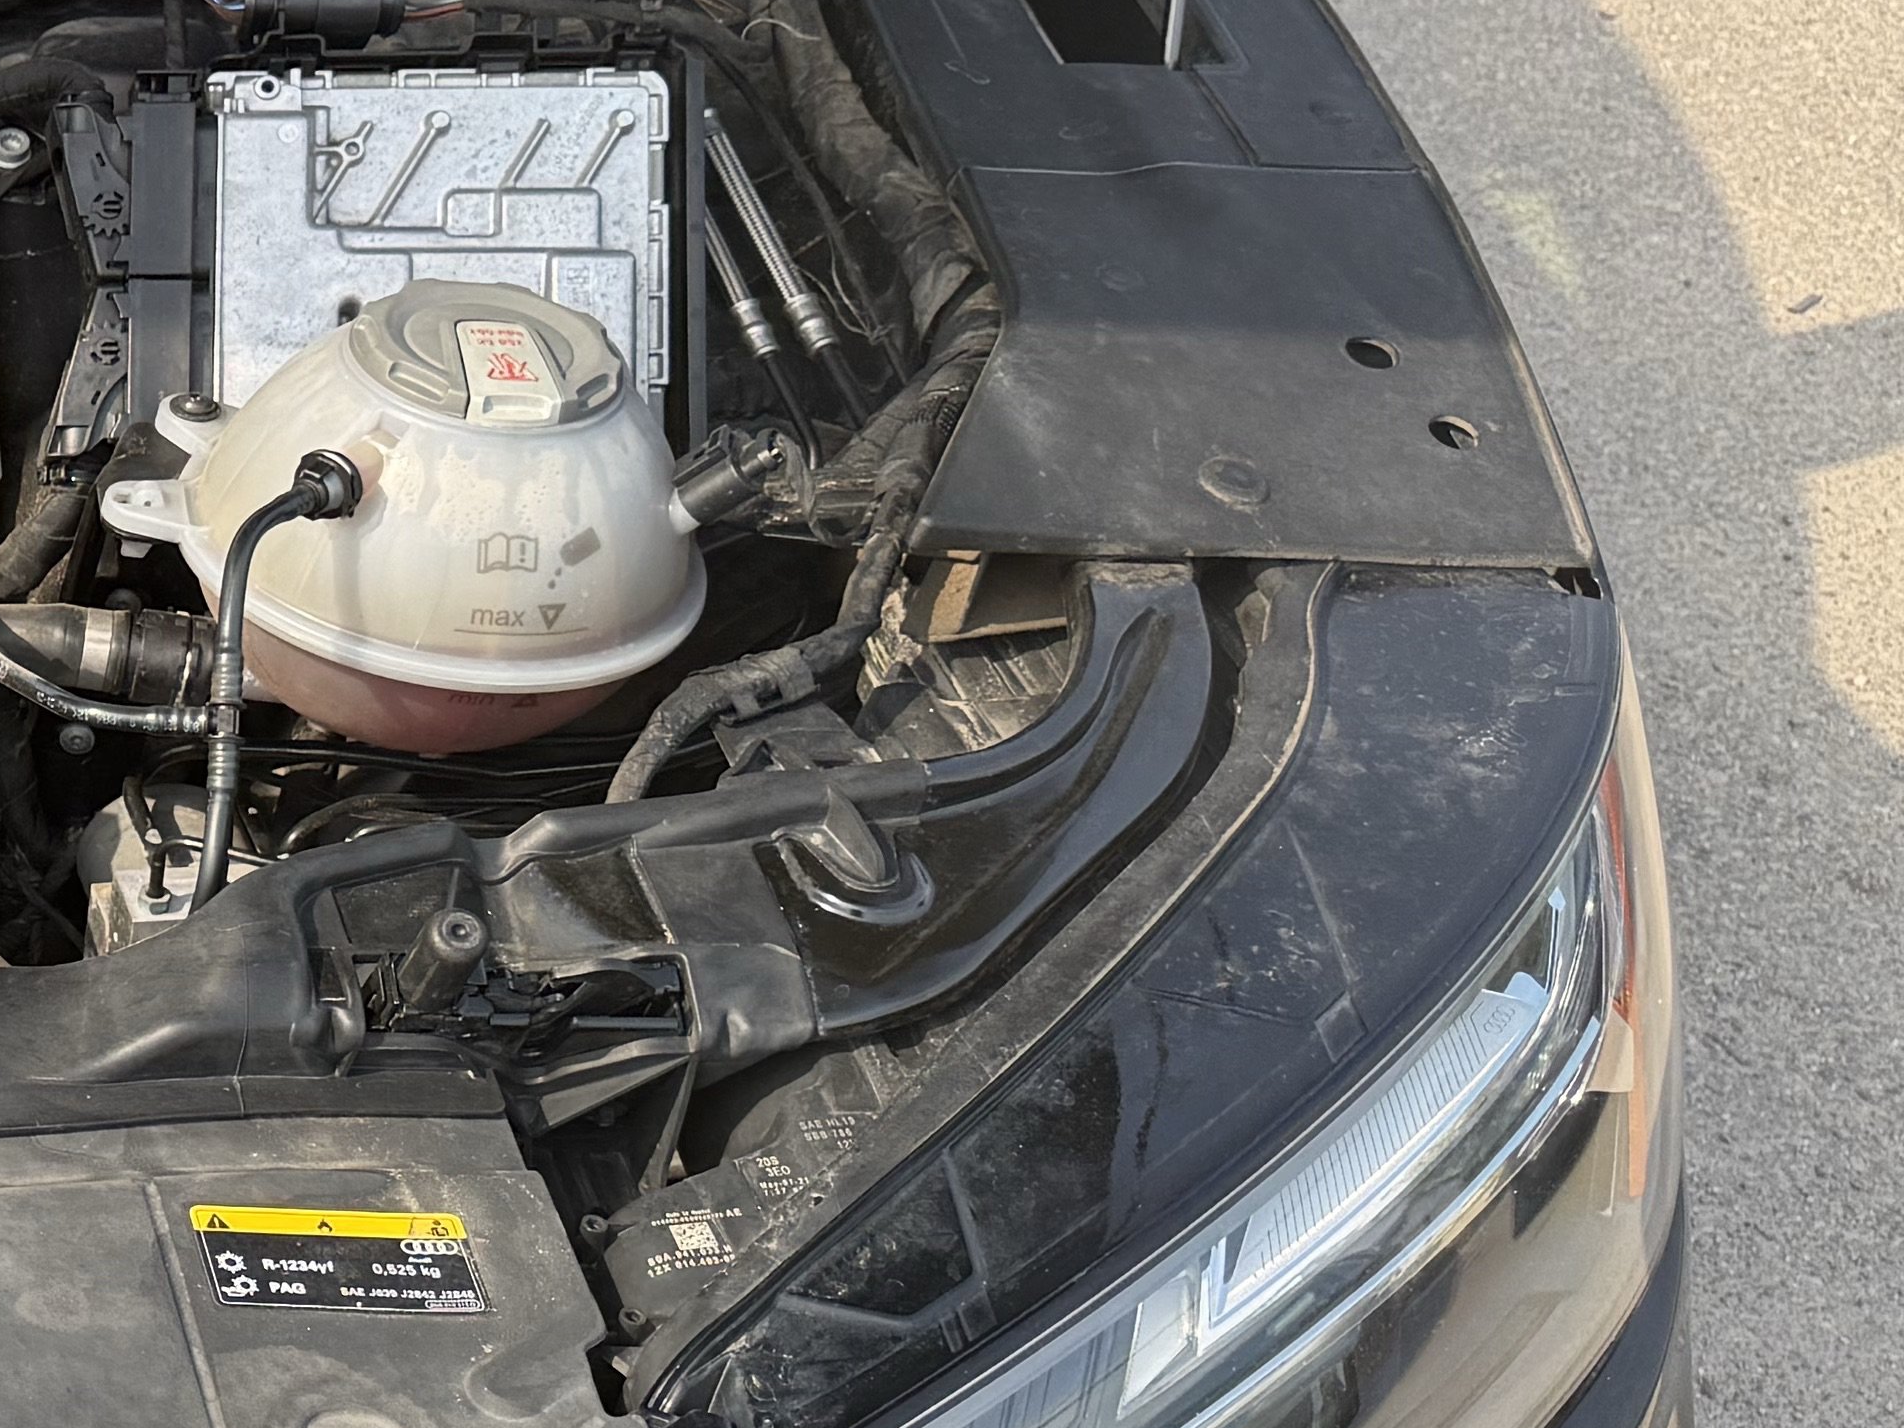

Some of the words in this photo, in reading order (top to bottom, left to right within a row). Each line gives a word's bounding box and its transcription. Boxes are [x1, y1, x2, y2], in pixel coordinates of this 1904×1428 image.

[470, 608, 525, 627] max
[755, 1155, 779, 1168] 20S
[372, 1263, 417, 1276] 0,525
[420, 1264, 441, 1278] kg
[269, 1280, 307, 1294] PAG
[340, 1286, 365, 1296] SAE
